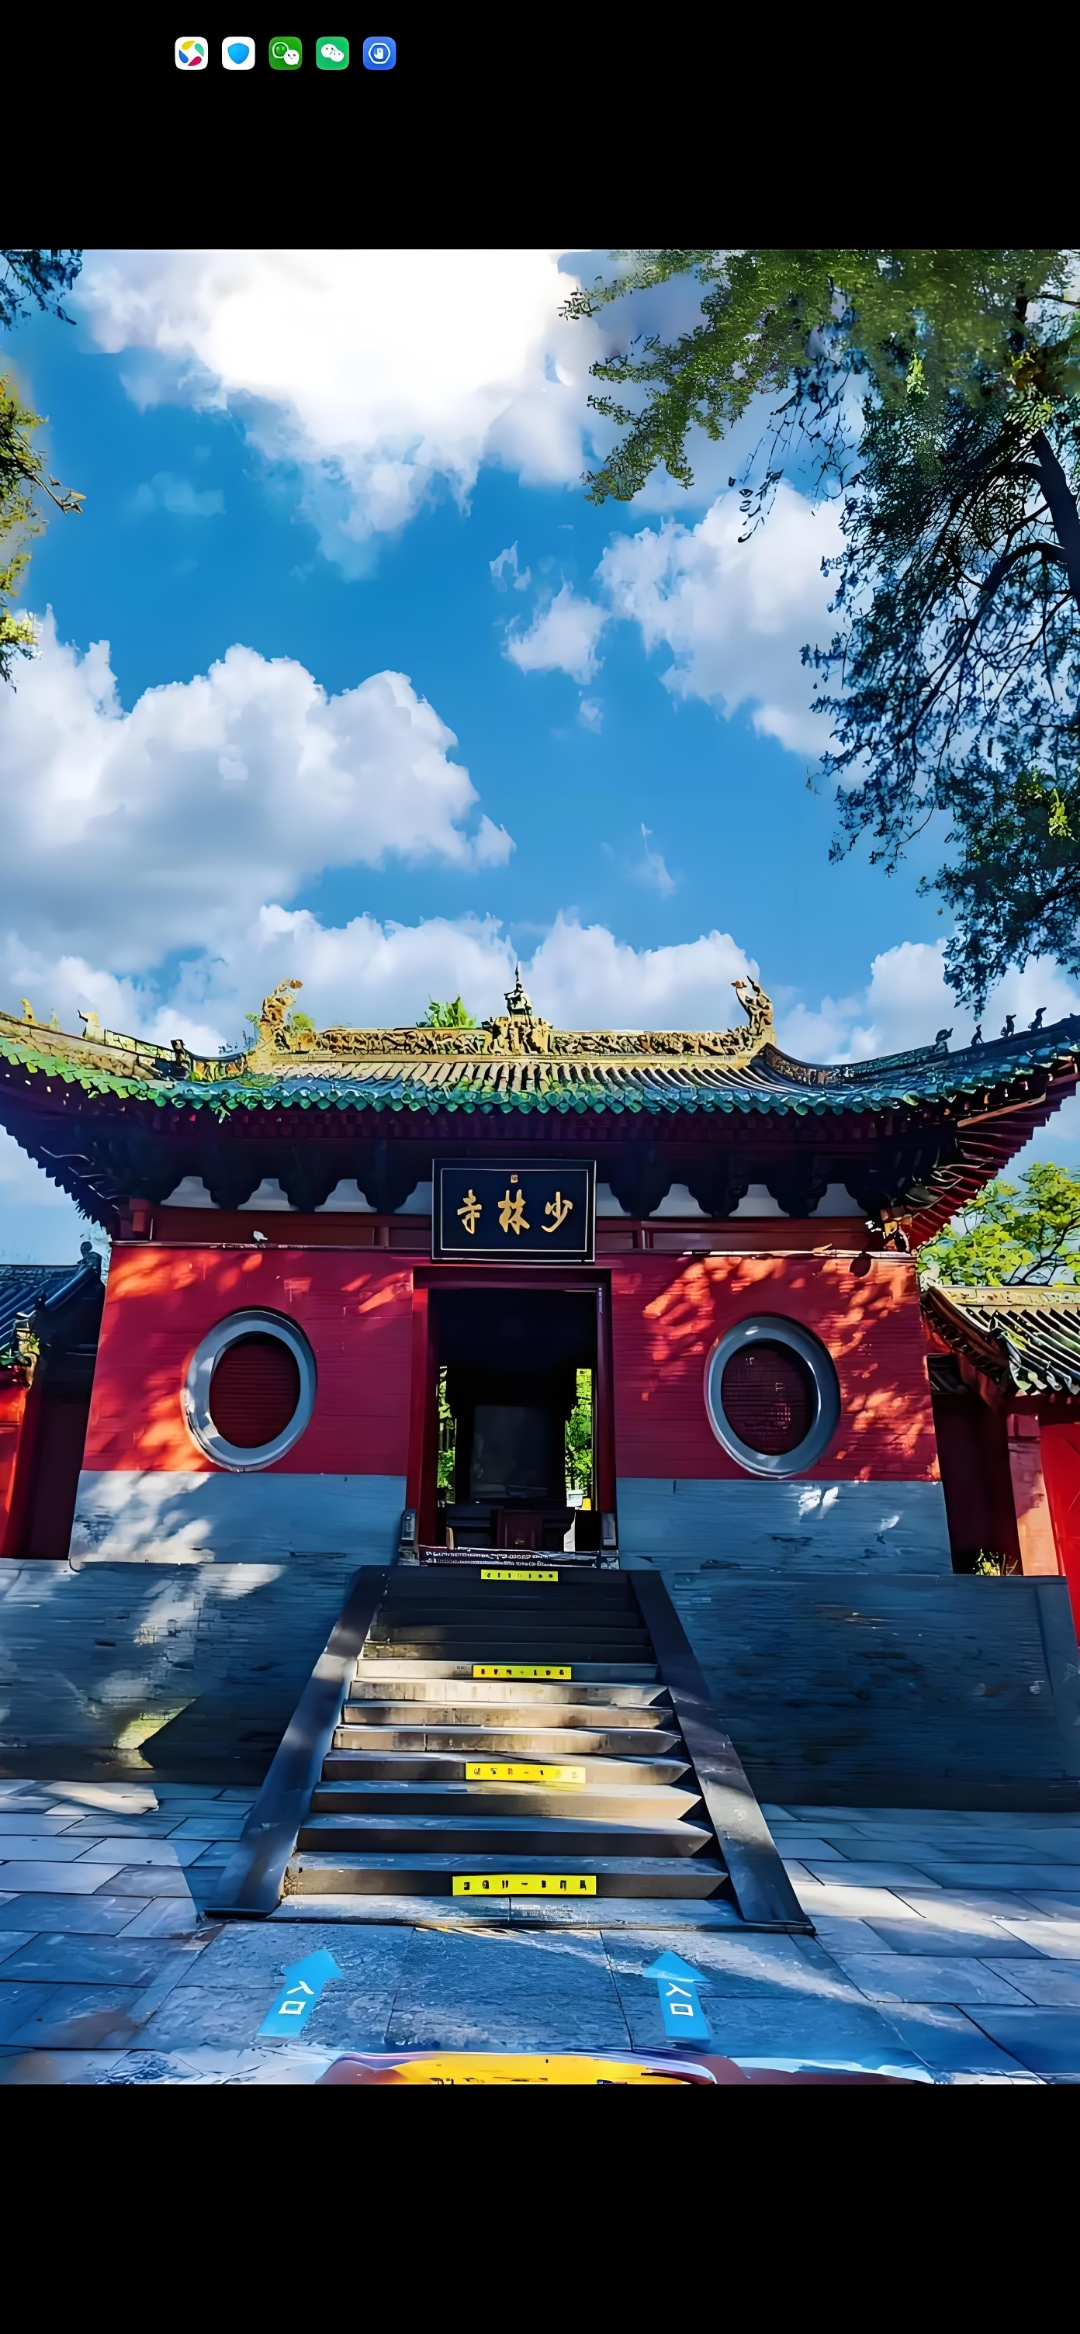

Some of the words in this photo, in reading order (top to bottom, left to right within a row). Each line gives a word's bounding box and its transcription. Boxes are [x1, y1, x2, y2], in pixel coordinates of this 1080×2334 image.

[457, 1189, 573, 1235] 少林寺
[278, 1980, 315, 2015] 入口
[665, 1982, 694, 2017] 入口
